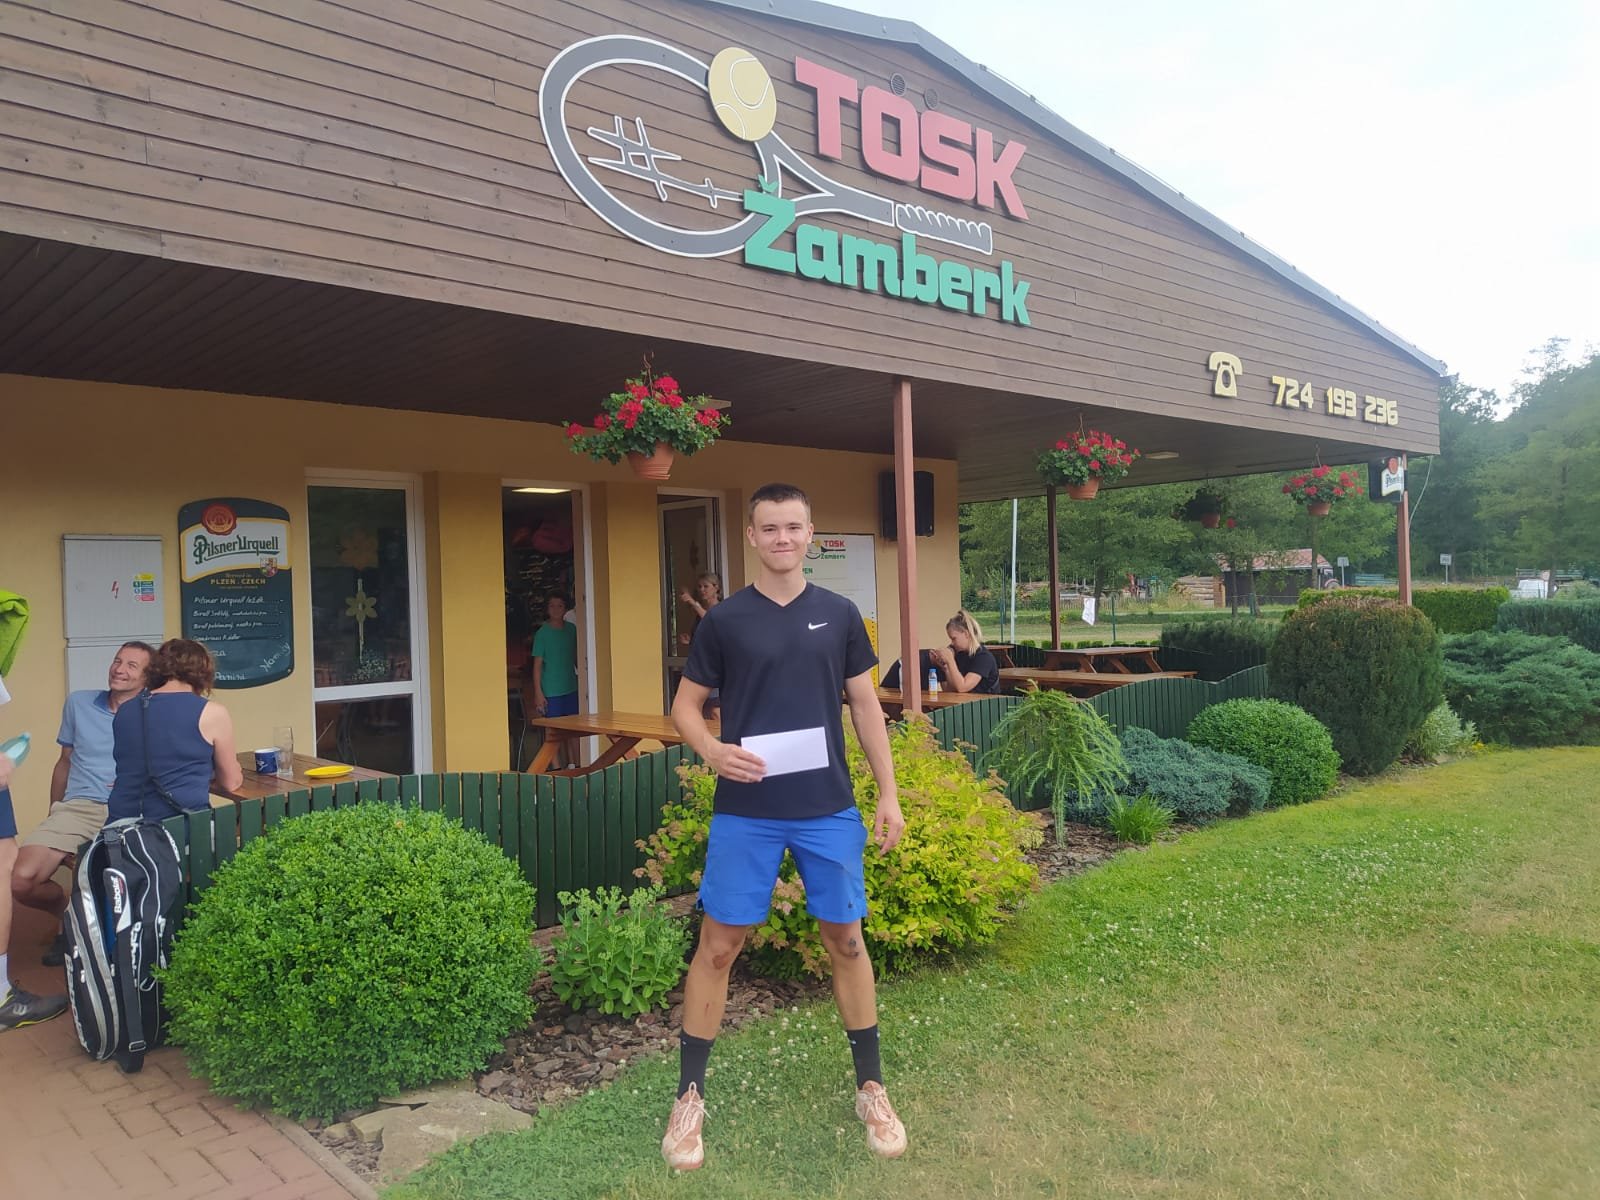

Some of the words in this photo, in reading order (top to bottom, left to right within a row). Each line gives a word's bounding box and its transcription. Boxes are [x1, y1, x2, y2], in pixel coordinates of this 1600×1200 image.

[795, 56, 1029, 220] TOSK
[744, 175, 1030, 326] Žamberk
[1272, 375, 1314, 409] 724
[1327, 386, 1357, 417] 193
[1365, 395, 1399, 426] 236
[193, 534, 237, 565] Pilsner
[237, 534, 279, 556] Urquell
[111, 875, 122, 913] Babolat
